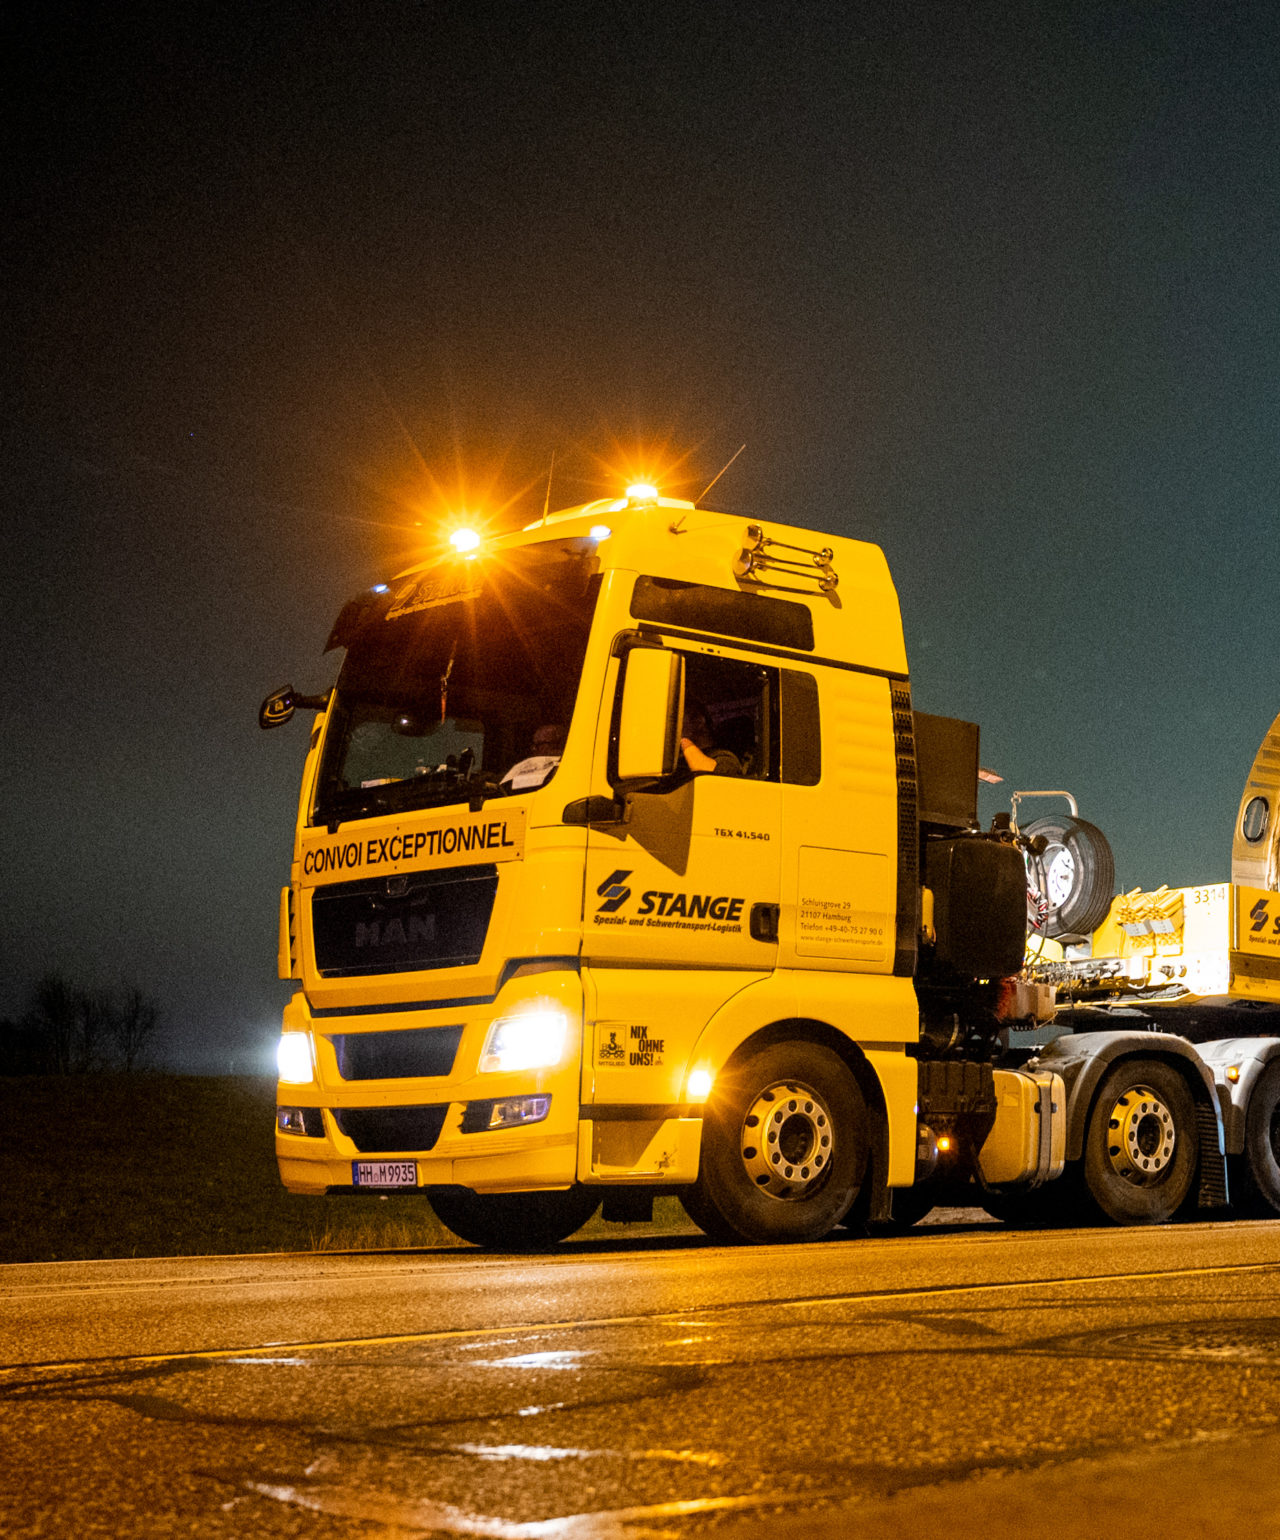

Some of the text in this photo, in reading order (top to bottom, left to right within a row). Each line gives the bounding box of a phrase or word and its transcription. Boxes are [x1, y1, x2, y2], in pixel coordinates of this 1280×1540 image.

[736, 831, 770, 841] 41.540
[304, 822, 514, 875] CONVOI EXCEPTIONNEL
[1194, 887, 1225, 904] 3314
[637, 891, 745, 921] STANGE
[842, 901, 851, 909] 29
[800, 910, 852, 923] 21107 Hamburg
[355, 913, 436, 948] MAN
[593, 914, 742, 934] Spezial- und Schwertransport-Logistik
[800, 922, 823, 931] Telefon
[1249, 934, 1267, 944] Spezial-
[630, 1025, 648, 1039] NIX
[639, 1039, 665, 1053] OHNE
[629, 1052, 654, 1066] UNS!
[359, 1165, 373, 1182] HH
